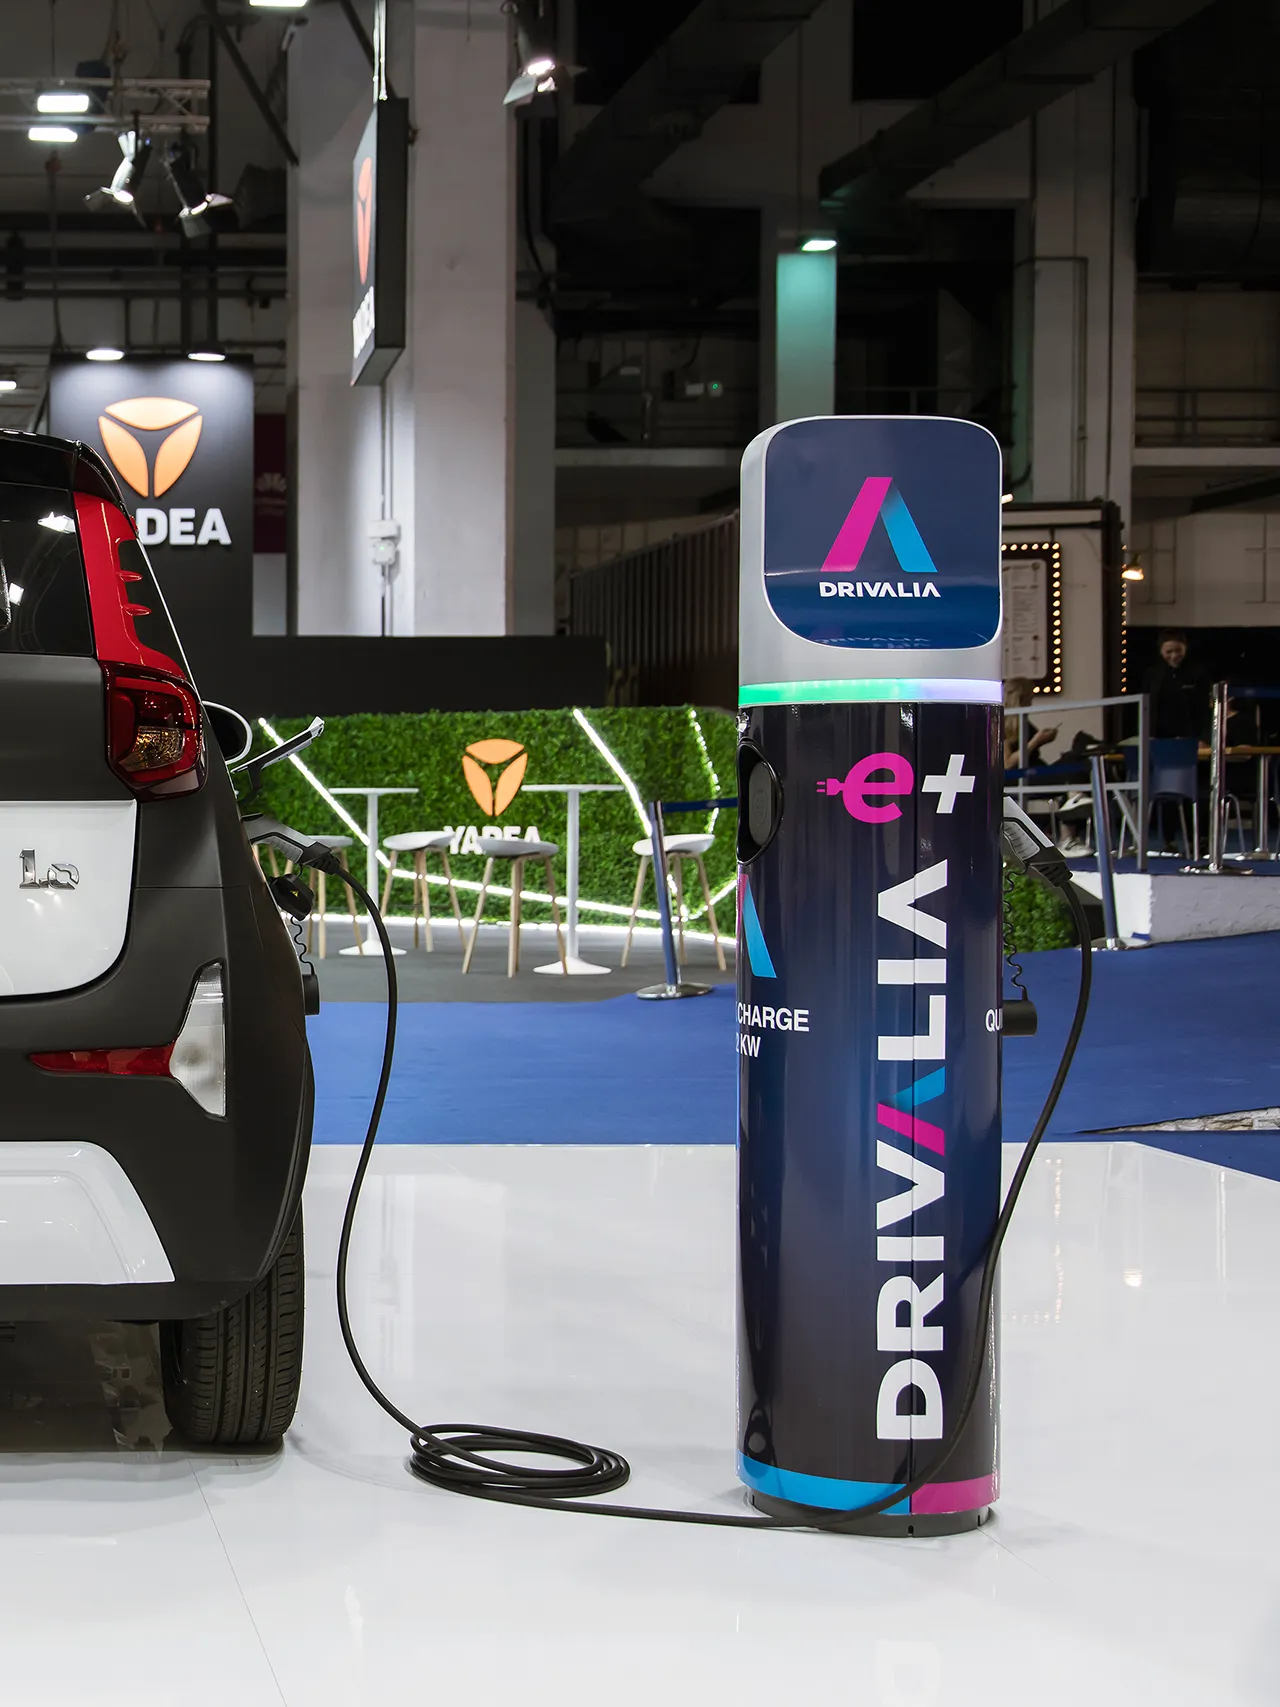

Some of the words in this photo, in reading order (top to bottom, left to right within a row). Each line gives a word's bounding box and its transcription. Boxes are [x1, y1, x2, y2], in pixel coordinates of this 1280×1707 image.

[136, 508, 232, 545] DEA
[819, 581, 941, 598] DRIVALIA
[737, 1001, 810, 1032] CHARGE
[740, 1032, 761, 1058] KW
[876, 858, 948, 1440] DRIVALIA
